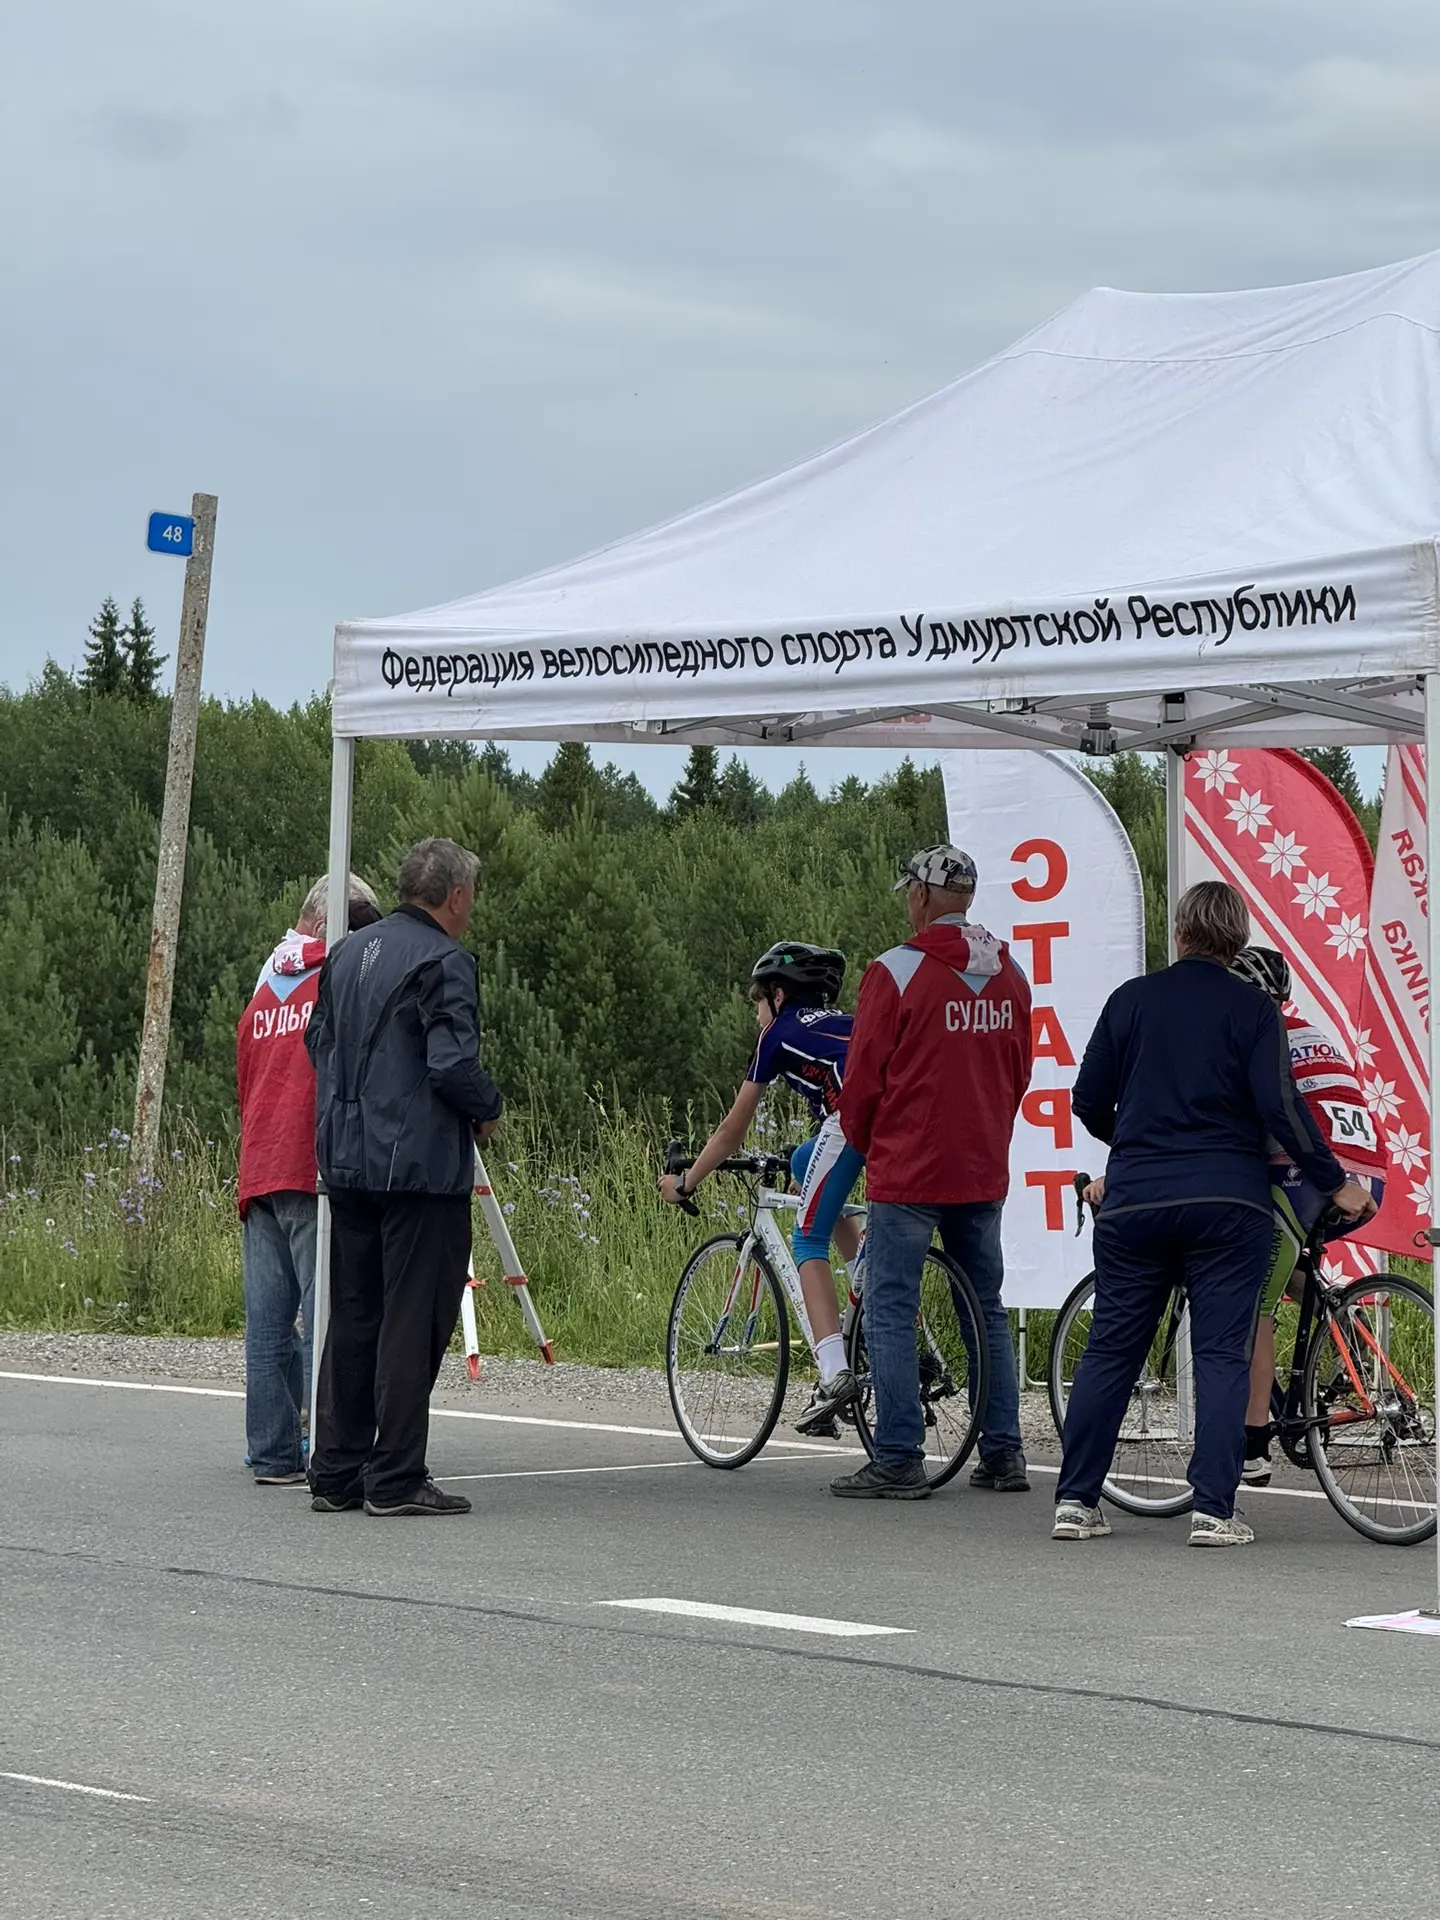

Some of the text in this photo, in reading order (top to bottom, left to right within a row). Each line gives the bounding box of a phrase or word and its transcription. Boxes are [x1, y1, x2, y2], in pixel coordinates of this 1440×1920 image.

[162, 525, 183, 543] 48
[381, 584, 1357, 698] Федерация велосипедного спорта Удмуртской Республики
[252, 1001, 314, 1040] СУДЬЯ
[945, 999, 1014, 1034] СУДЬЯ
[1330, 1106, 1371, 1141] 54
